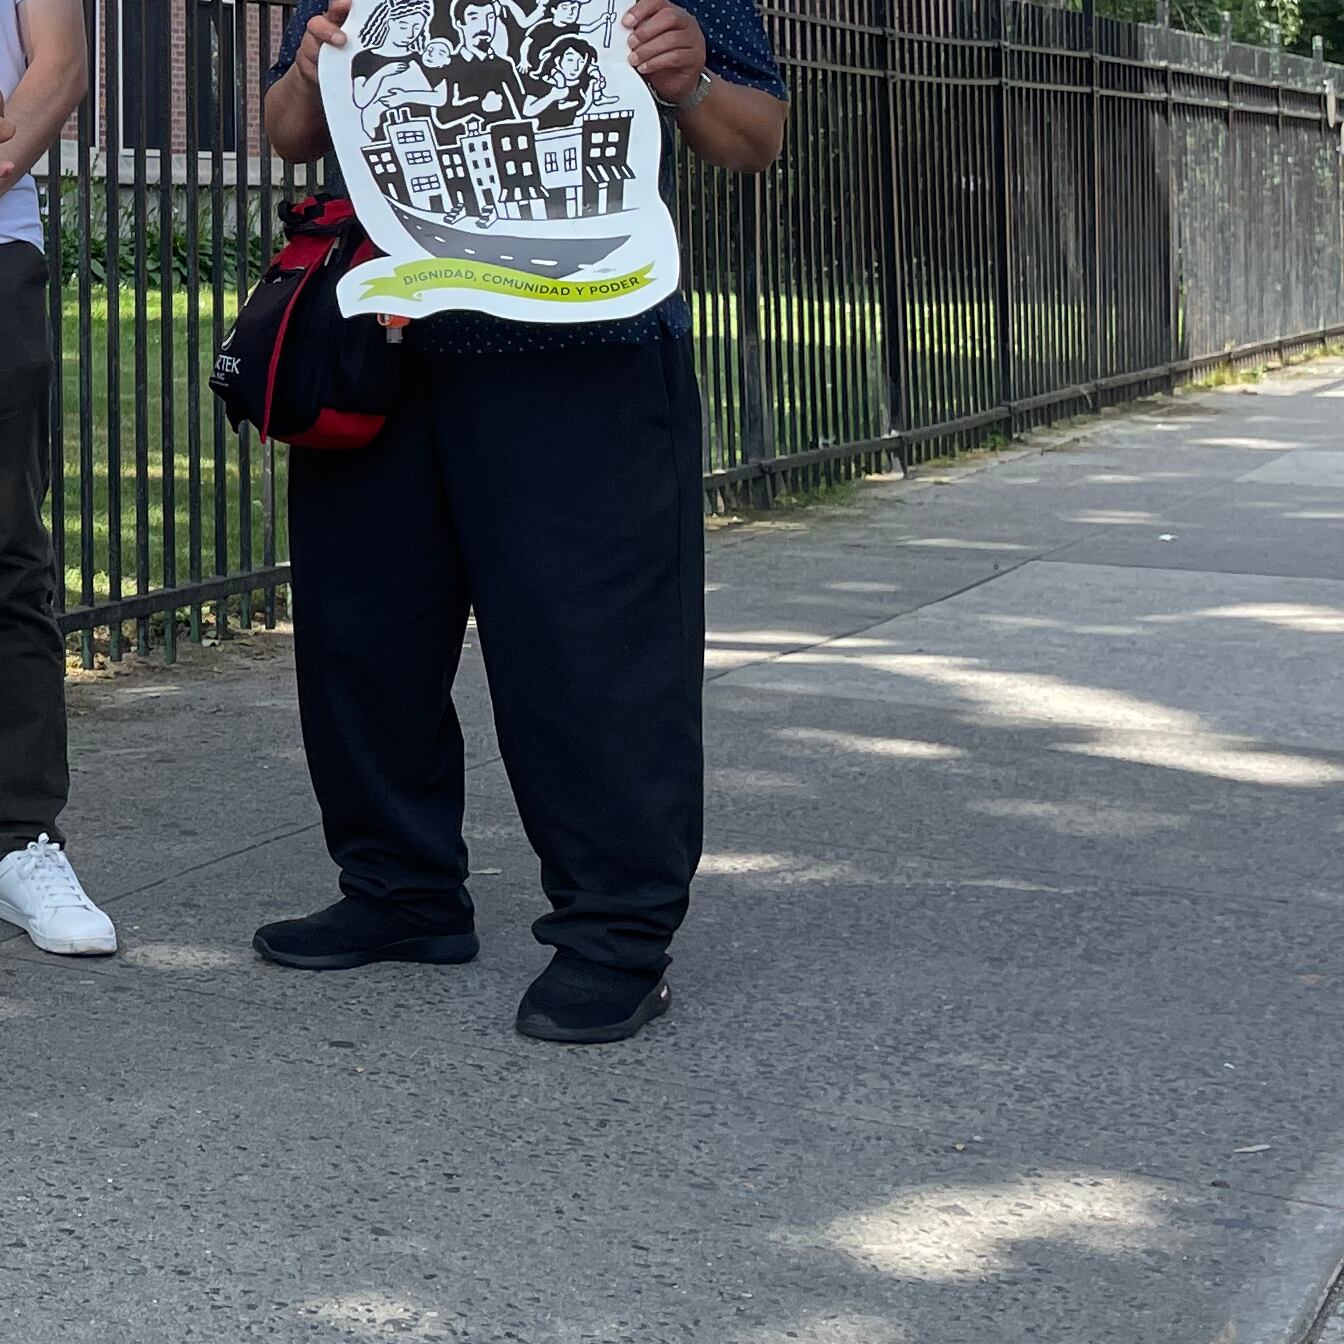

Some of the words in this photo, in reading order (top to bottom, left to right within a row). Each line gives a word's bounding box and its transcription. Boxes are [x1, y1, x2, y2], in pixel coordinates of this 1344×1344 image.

[402, 269, 477, 287] DIGNIDAD,
[482, 273, 571, 296] COMUNIDAD
[575, 286, 584, 296] Y
[589, 276, 640, 295] PODER
